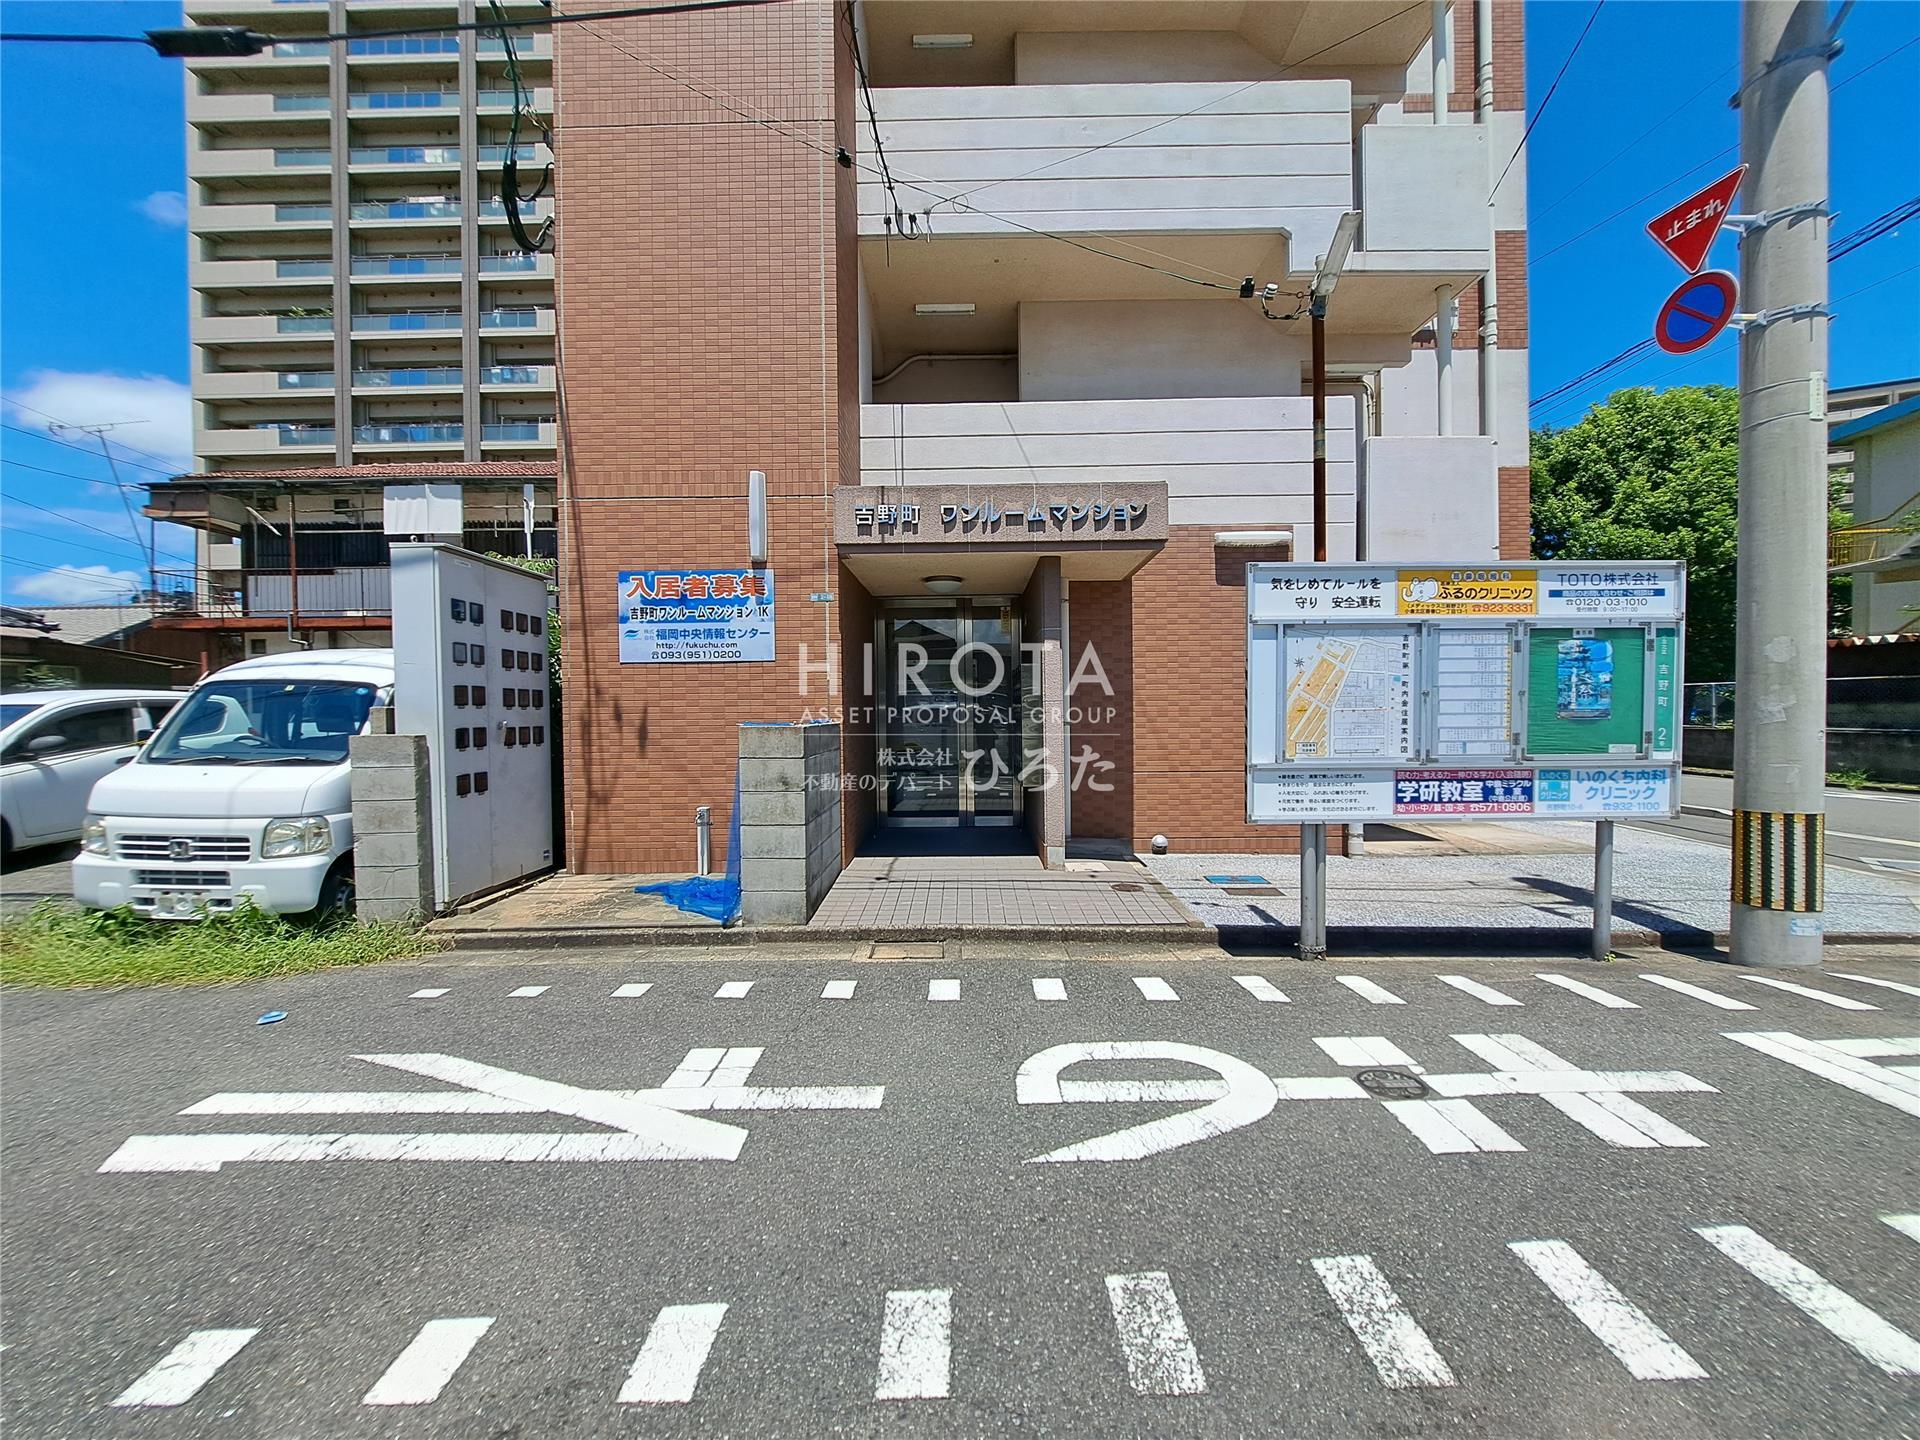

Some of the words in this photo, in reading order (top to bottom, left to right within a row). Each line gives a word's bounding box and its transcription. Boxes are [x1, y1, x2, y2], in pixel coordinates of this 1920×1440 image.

[1665, 199, 1725, 242] 止まれ
[855, 503, 920, 525] 吉野町
[940, 503, 1147, 523] ワンルームマンション
[1271, 577, 1381, 590] 気をしめてルールを
[1557, 572, 1659, 587] TOTO株式会社
[627, 576, 767, 598] 入居者募集
[1439, 587, 1533, 600] ふるのクリニック
[1295, 597, 1318, 608] 守り
[1332, 596, 1381, 608] 安全運転
[630, 607, 753, 620] 吉野町ワンルームマンション
[758, 607, 769, 617] 1K
[656, 628, 770, 640] 福岡中央情報センター
[660, 650, 742, 659] 093(951)0200
[1657, 664, 1669, 707] 吉野町
[1577, 769, 1667, 784] いのくち内科
[1397, 781, 1484, 802] 学研教室
[1585, 786, 1656, 800] クリニック
